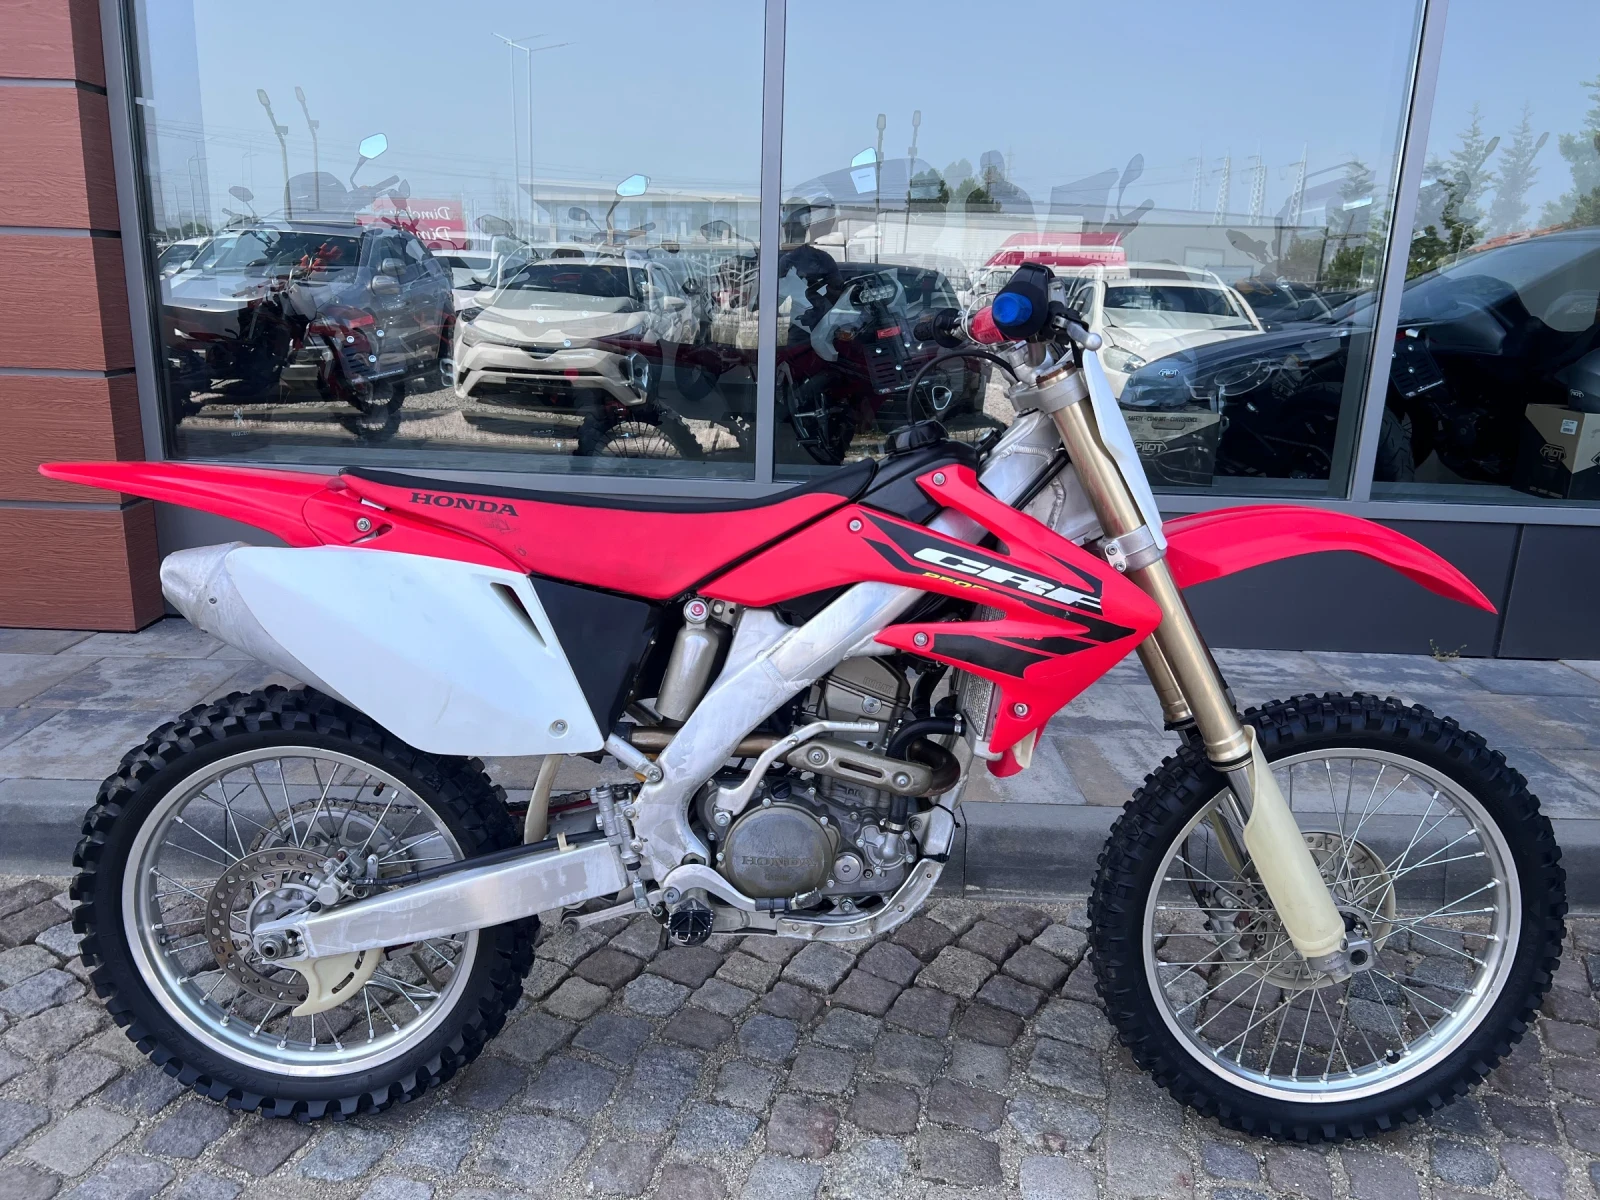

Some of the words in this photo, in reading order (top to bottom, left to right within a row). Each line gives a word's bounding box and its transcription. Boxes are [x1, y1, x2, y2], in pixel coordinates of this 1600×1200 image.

[409, 492, 519, 517] HONDA
[913, 548, 1102, 609] CRF
[741, 855, 817, 867] HONDA
